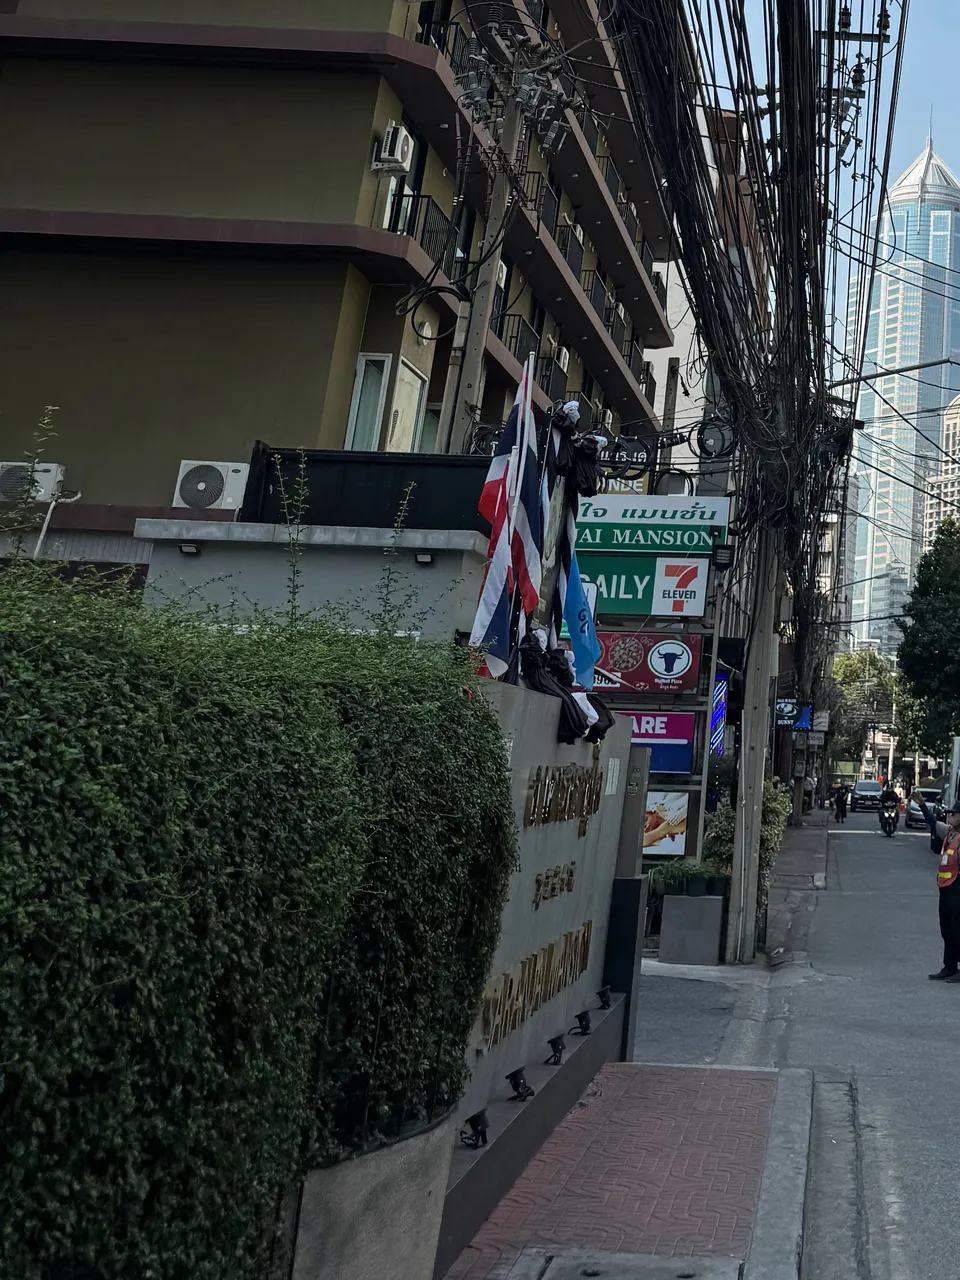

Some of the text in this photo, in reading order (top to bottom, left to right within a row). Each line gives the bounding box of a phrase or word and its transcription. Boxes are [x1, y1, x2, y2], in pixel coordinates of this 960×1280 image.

[621, 502, 718, 521] แมนชั่น
[613, 528, 713, 547] MANSION
